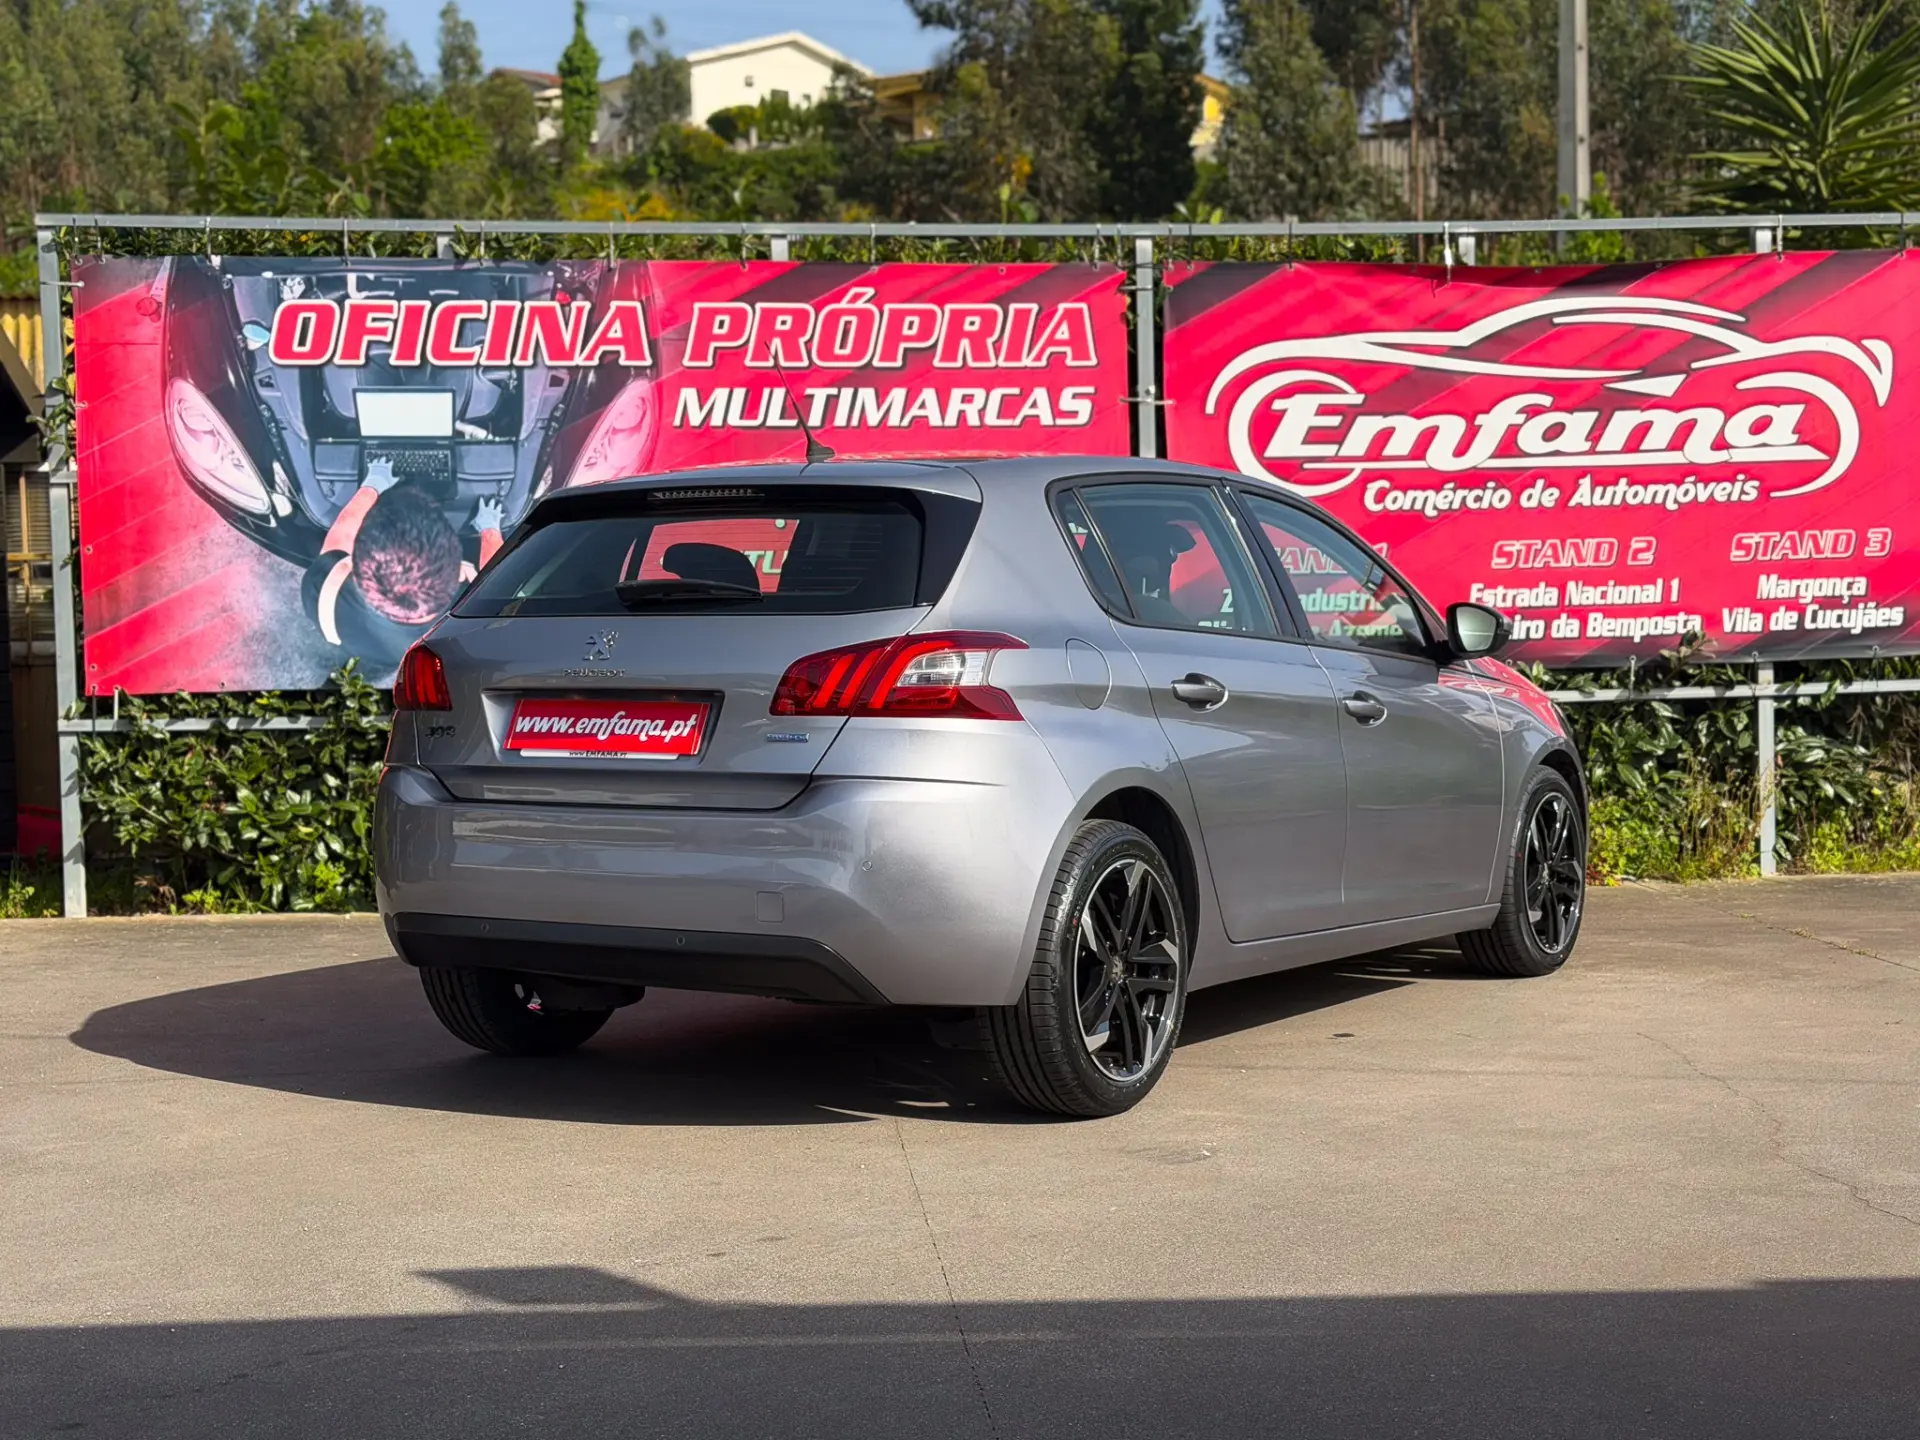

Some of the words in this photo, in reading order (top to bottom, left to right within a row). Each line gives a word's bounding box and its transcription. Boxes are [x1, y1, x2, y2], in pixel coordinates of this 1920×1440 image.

[268, 299, 652, 366] OFICINA
[682, 287, 1098, 368] PRÓPRIA
[672, 386, 1095, 427] MULTIMARCAS
[1262, 393, 1807, 470] Emfama
[1364, 479, 1511, 518] Comércio
[1519, 479, 1560, 509] de
[1568, 474, 1759, 511] Automóveis
[1491, 538, 1618, 569] STAND
[1627, 536, 1656, 566] 2
[1730, 529, 1856, 562] STAND
[1864, 527, 1892, 557] 3
[1469, 581, 1559, 608] Estrada
[1565, 578, 1664, 606] Nacional
[1670, 577, 1681, 603] 1
[1756, 574, 1868, 604] Margonça
[1551, 613, 1580, 639] da
[1586, 612, 1702, 643] Bemposta
[1722, 607, 1764, 633] Vila
[1769, 606, 1799, 631] de
[1804, 601, 1905, 634] Cucujães
[563, 668, 626, 677] PEUGEOT
[515, 711, 698, 743] www.emfama.pt
